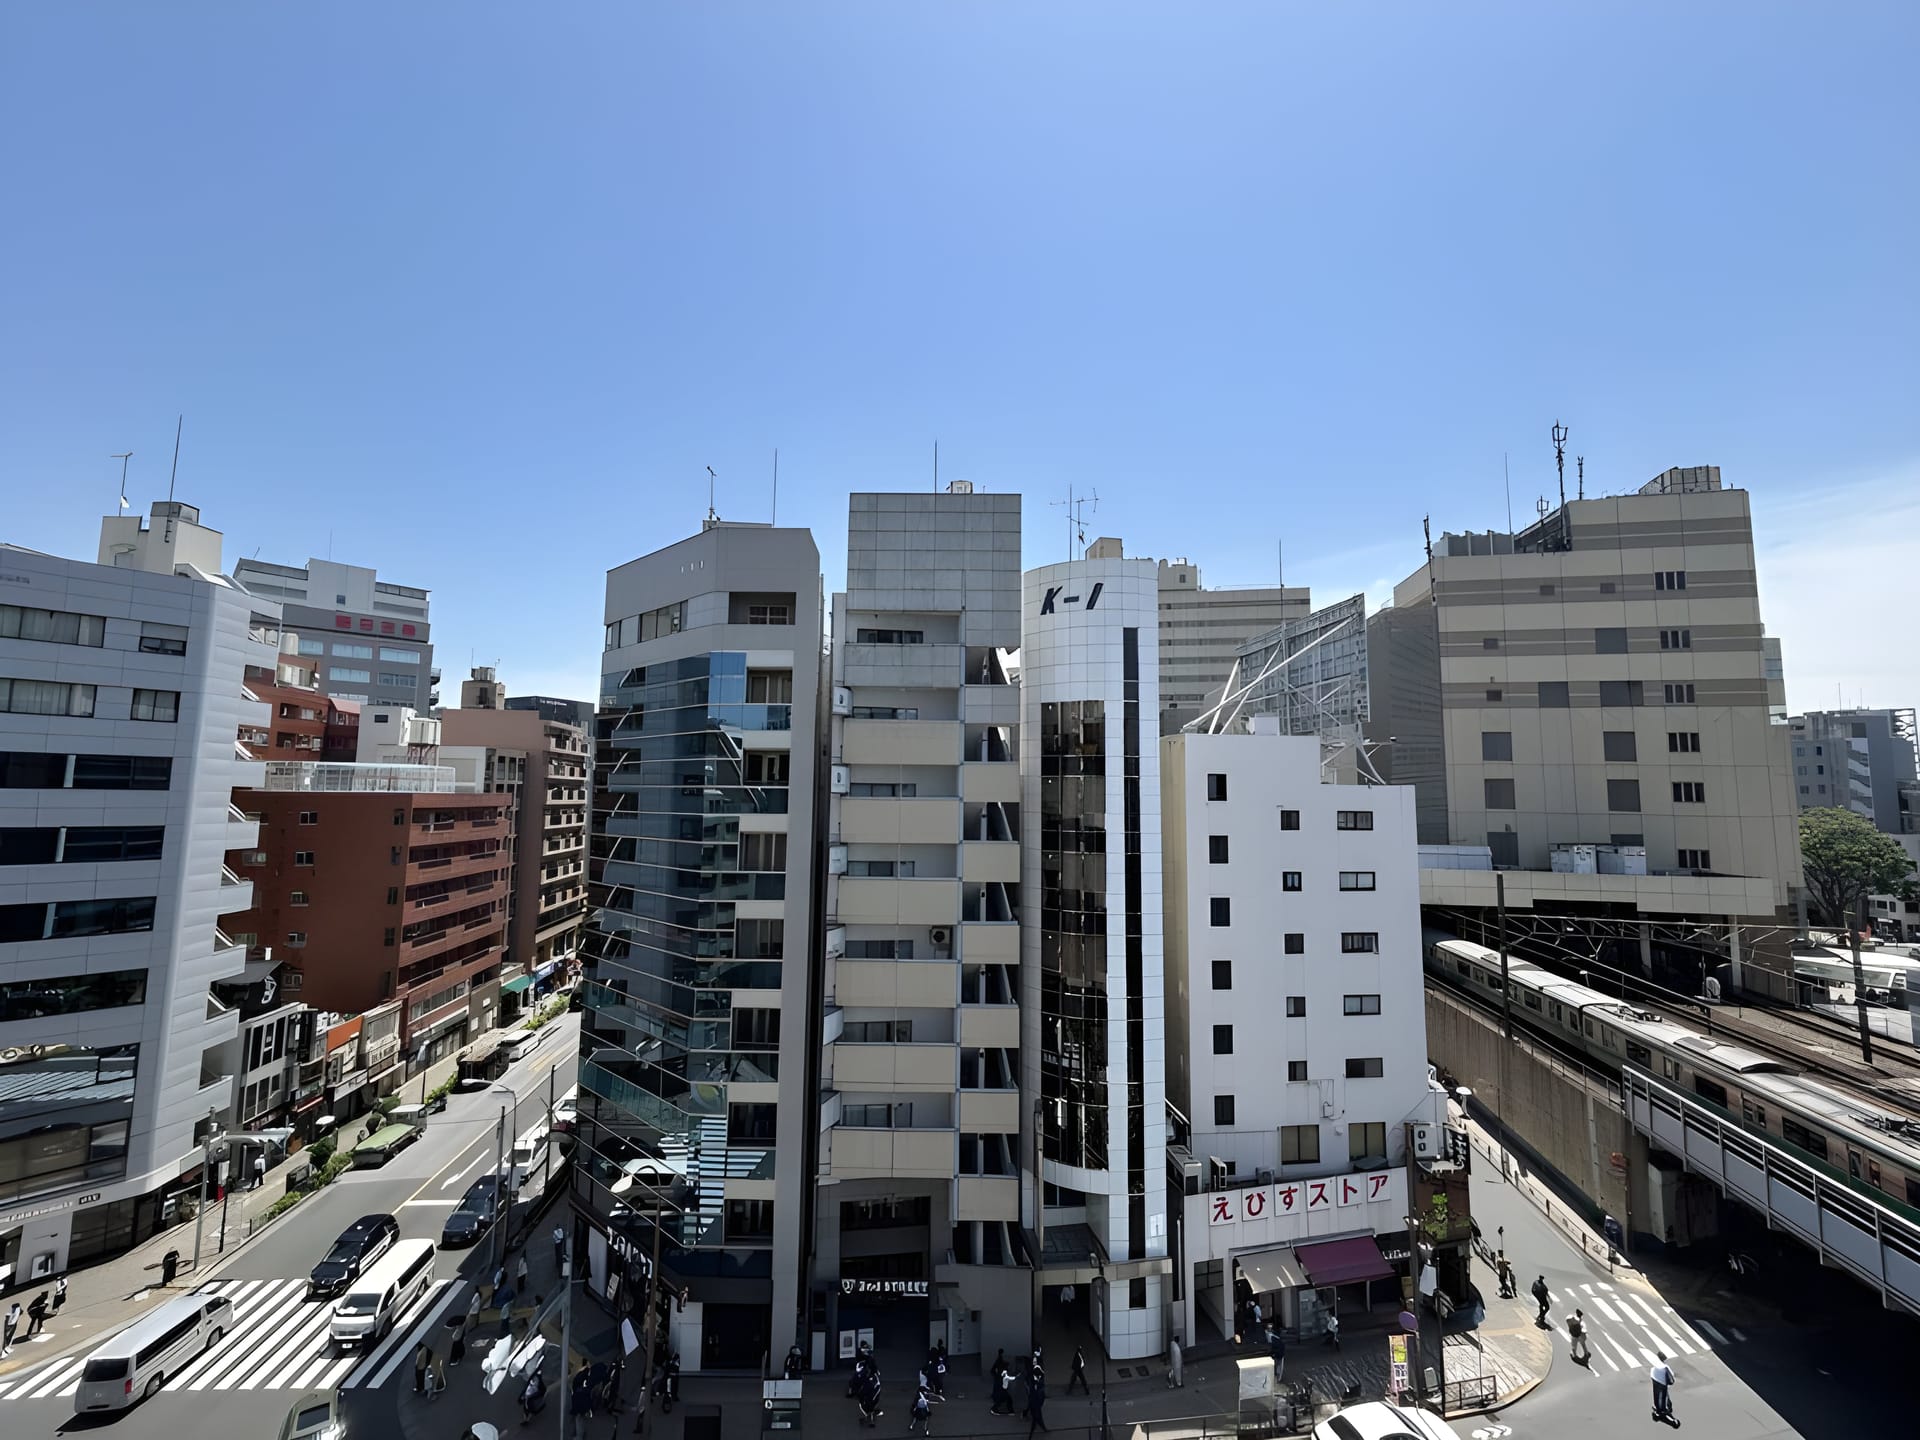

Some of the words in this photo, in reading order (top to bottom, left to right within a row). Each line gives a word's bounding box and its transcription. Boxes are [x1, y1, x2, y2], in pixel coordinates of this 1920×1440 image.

[1212, 1174, 1389, 1223] えびすストア
